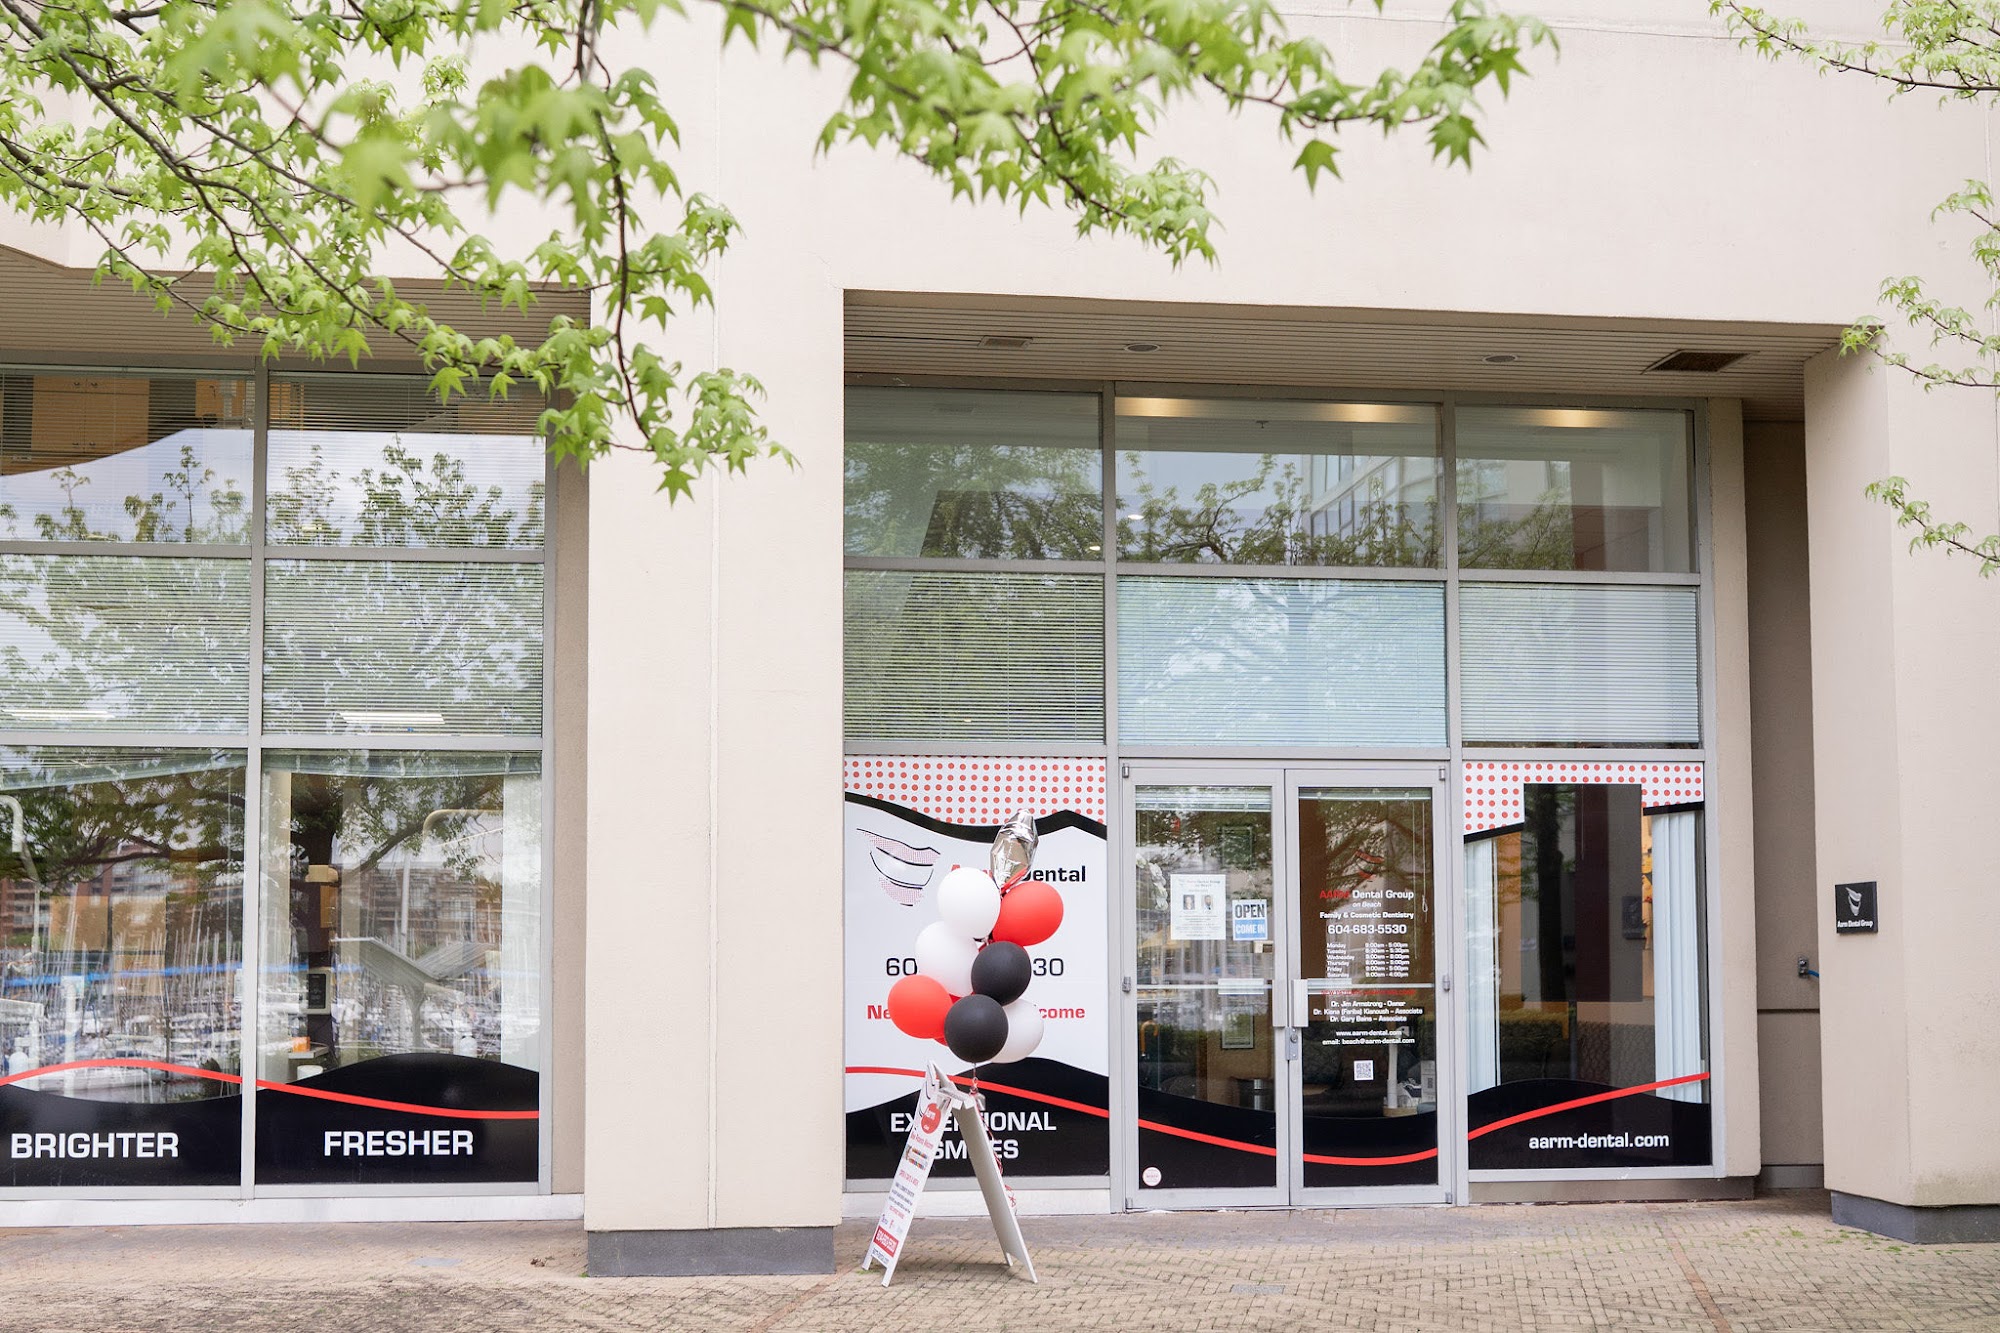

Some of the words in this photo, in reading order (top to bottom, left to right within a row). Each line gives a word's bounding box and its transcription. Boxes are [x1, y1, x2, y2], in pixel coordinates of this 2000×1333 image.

[1352, 889, 1383, 899] Dental
[1385, 889, 1415, 901] Group
[1234, 903, 1265, 919] OPEN
[1319, 911, 1342, 920] Family
[1350, 911, 1382, 919] Cosmetic
[1382, 911, 1415, 920] Dentistry
[1235, 923, 1258, 935] COME
[1258, 923, 1266, 934] IN
[1327, 924, 1407, 935] 604-683-5530
[1352, 1000, 1384, 1008] Armstrong
[867, 1005, 891, 1020] Ne
[1335, 1029, 1403, 1037] www.aarm-dental.com
[10, 1131, 181, 1159] BRIGHTER
[323, 1129, 475, 1157] FRESHER
[1528, 1131, 1671, 1150] aarm-dental.com
